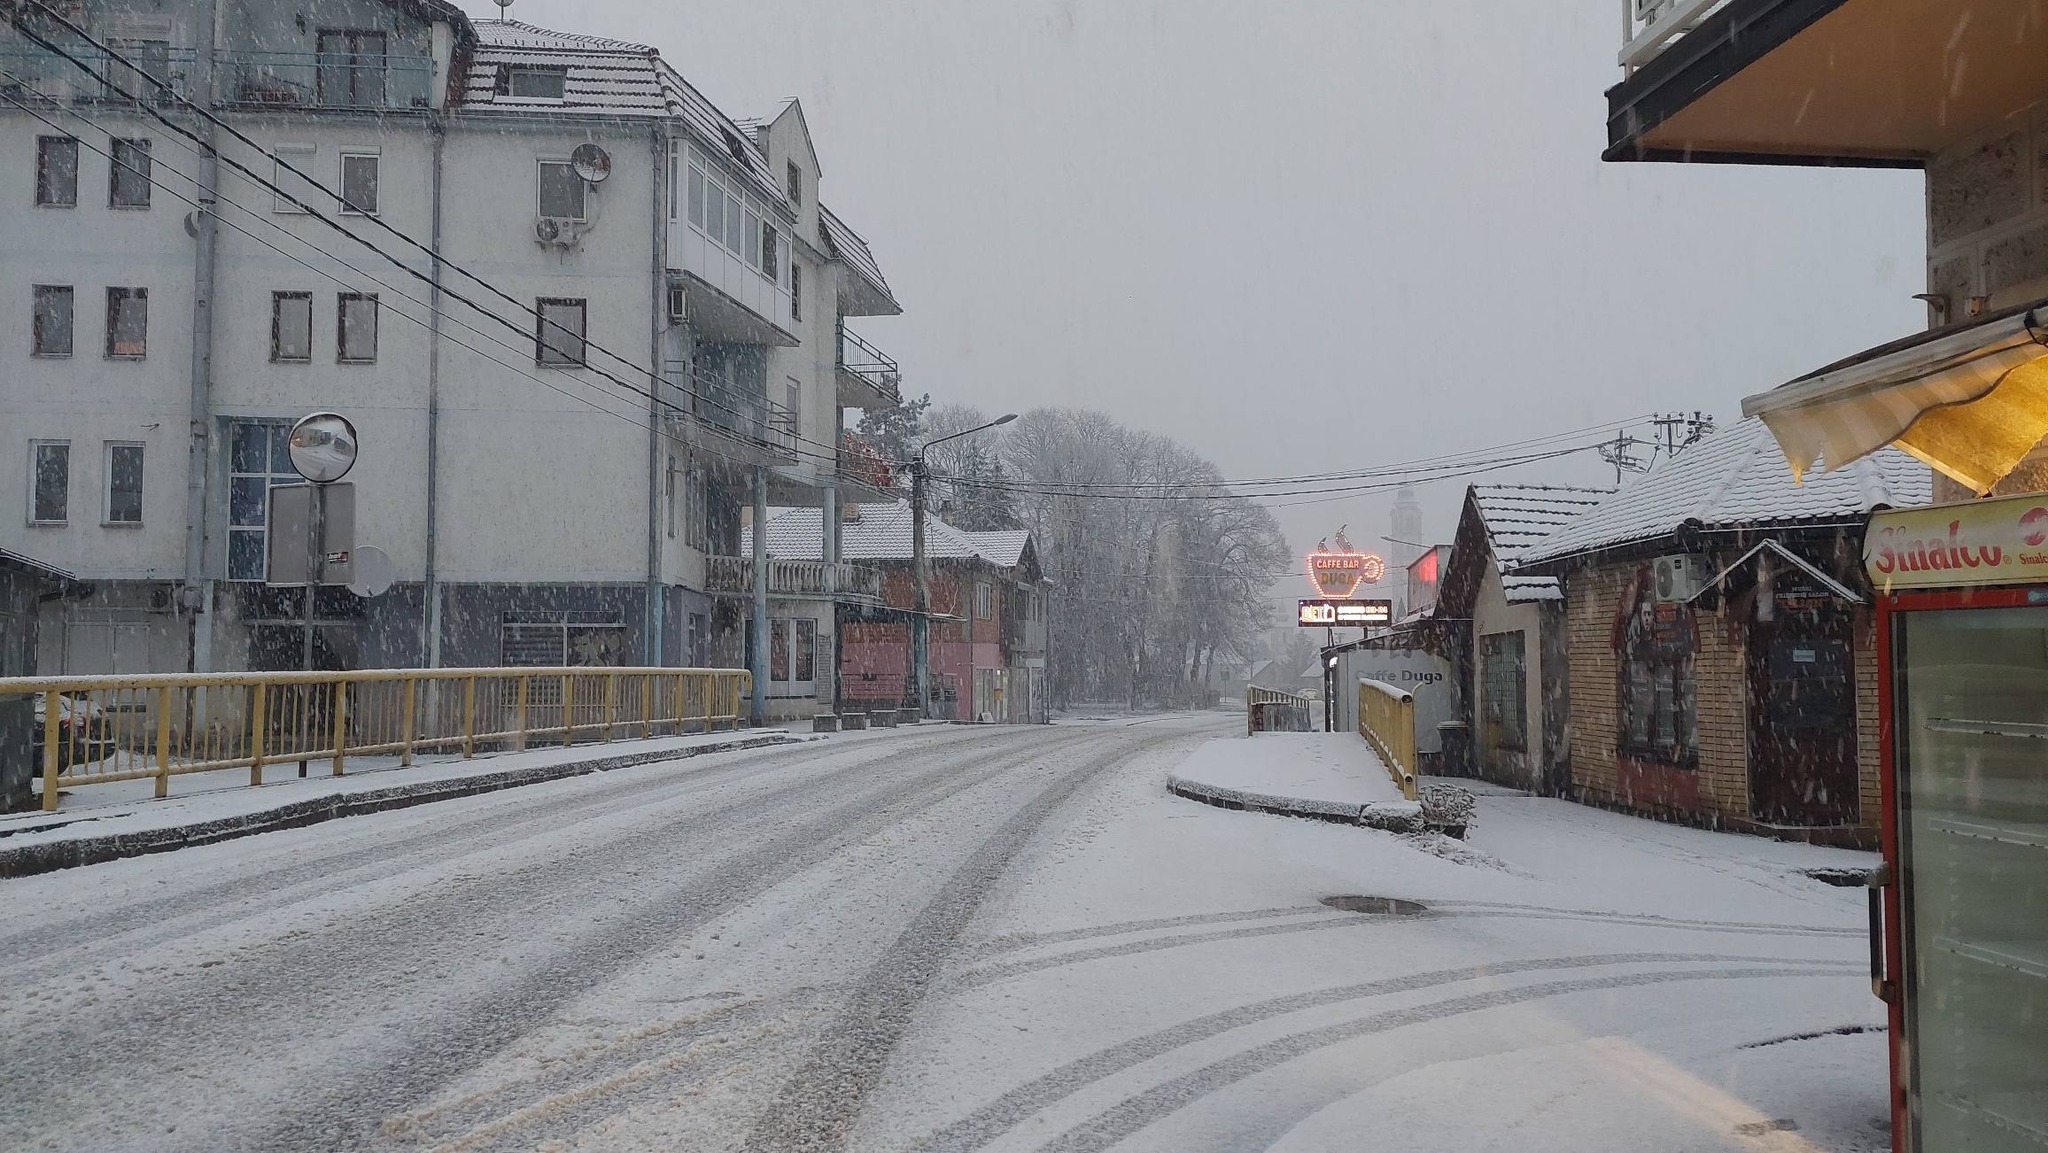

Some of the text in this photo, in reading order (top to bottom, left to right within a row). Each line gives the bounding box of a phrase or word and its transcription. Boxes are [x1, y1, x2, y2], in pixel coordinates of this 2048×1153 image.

[1875, 519, 2003, 574] Sinalco
[1316, 560, 1359, 569] CAFFE BAR
[1321, 572, 1354, 585] DUGA
[1355, 669, 1443, 685] Caffe Duga
